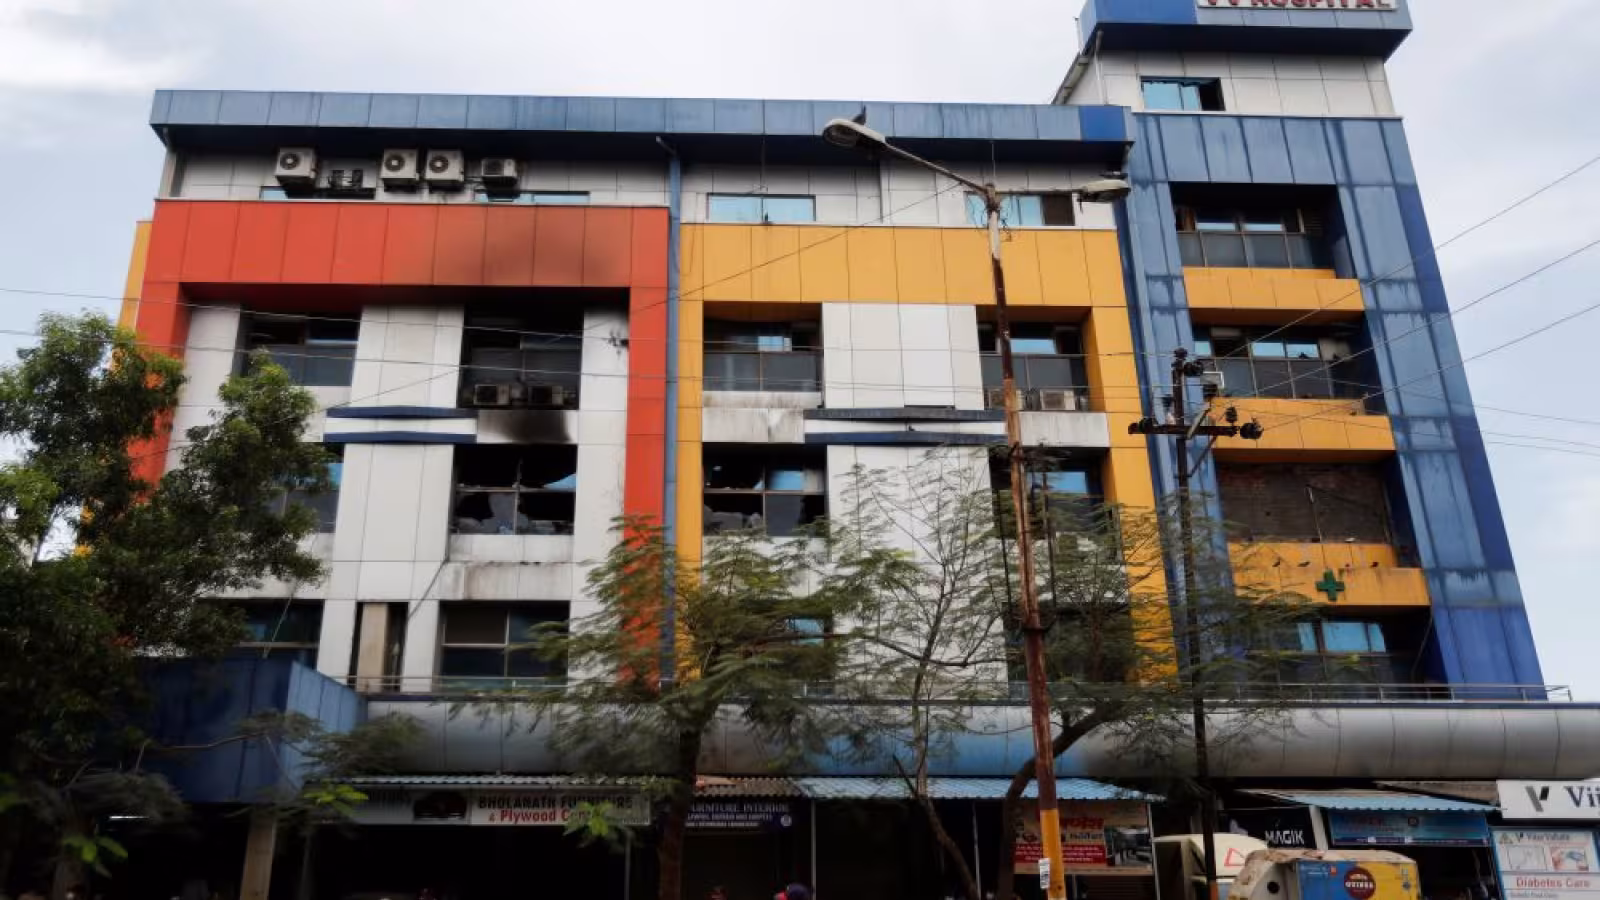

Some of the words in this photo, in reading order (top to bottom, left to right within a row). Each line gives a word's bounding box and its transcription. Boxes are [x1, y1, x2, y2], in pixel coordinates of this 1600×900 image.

[500, 809, 557, 825] Plywood
[1264, 829, 1305, 845] MAGIK
[1515, 877, 1563, 889] Diabetes
[1565, 878, 1592, 889] Care
